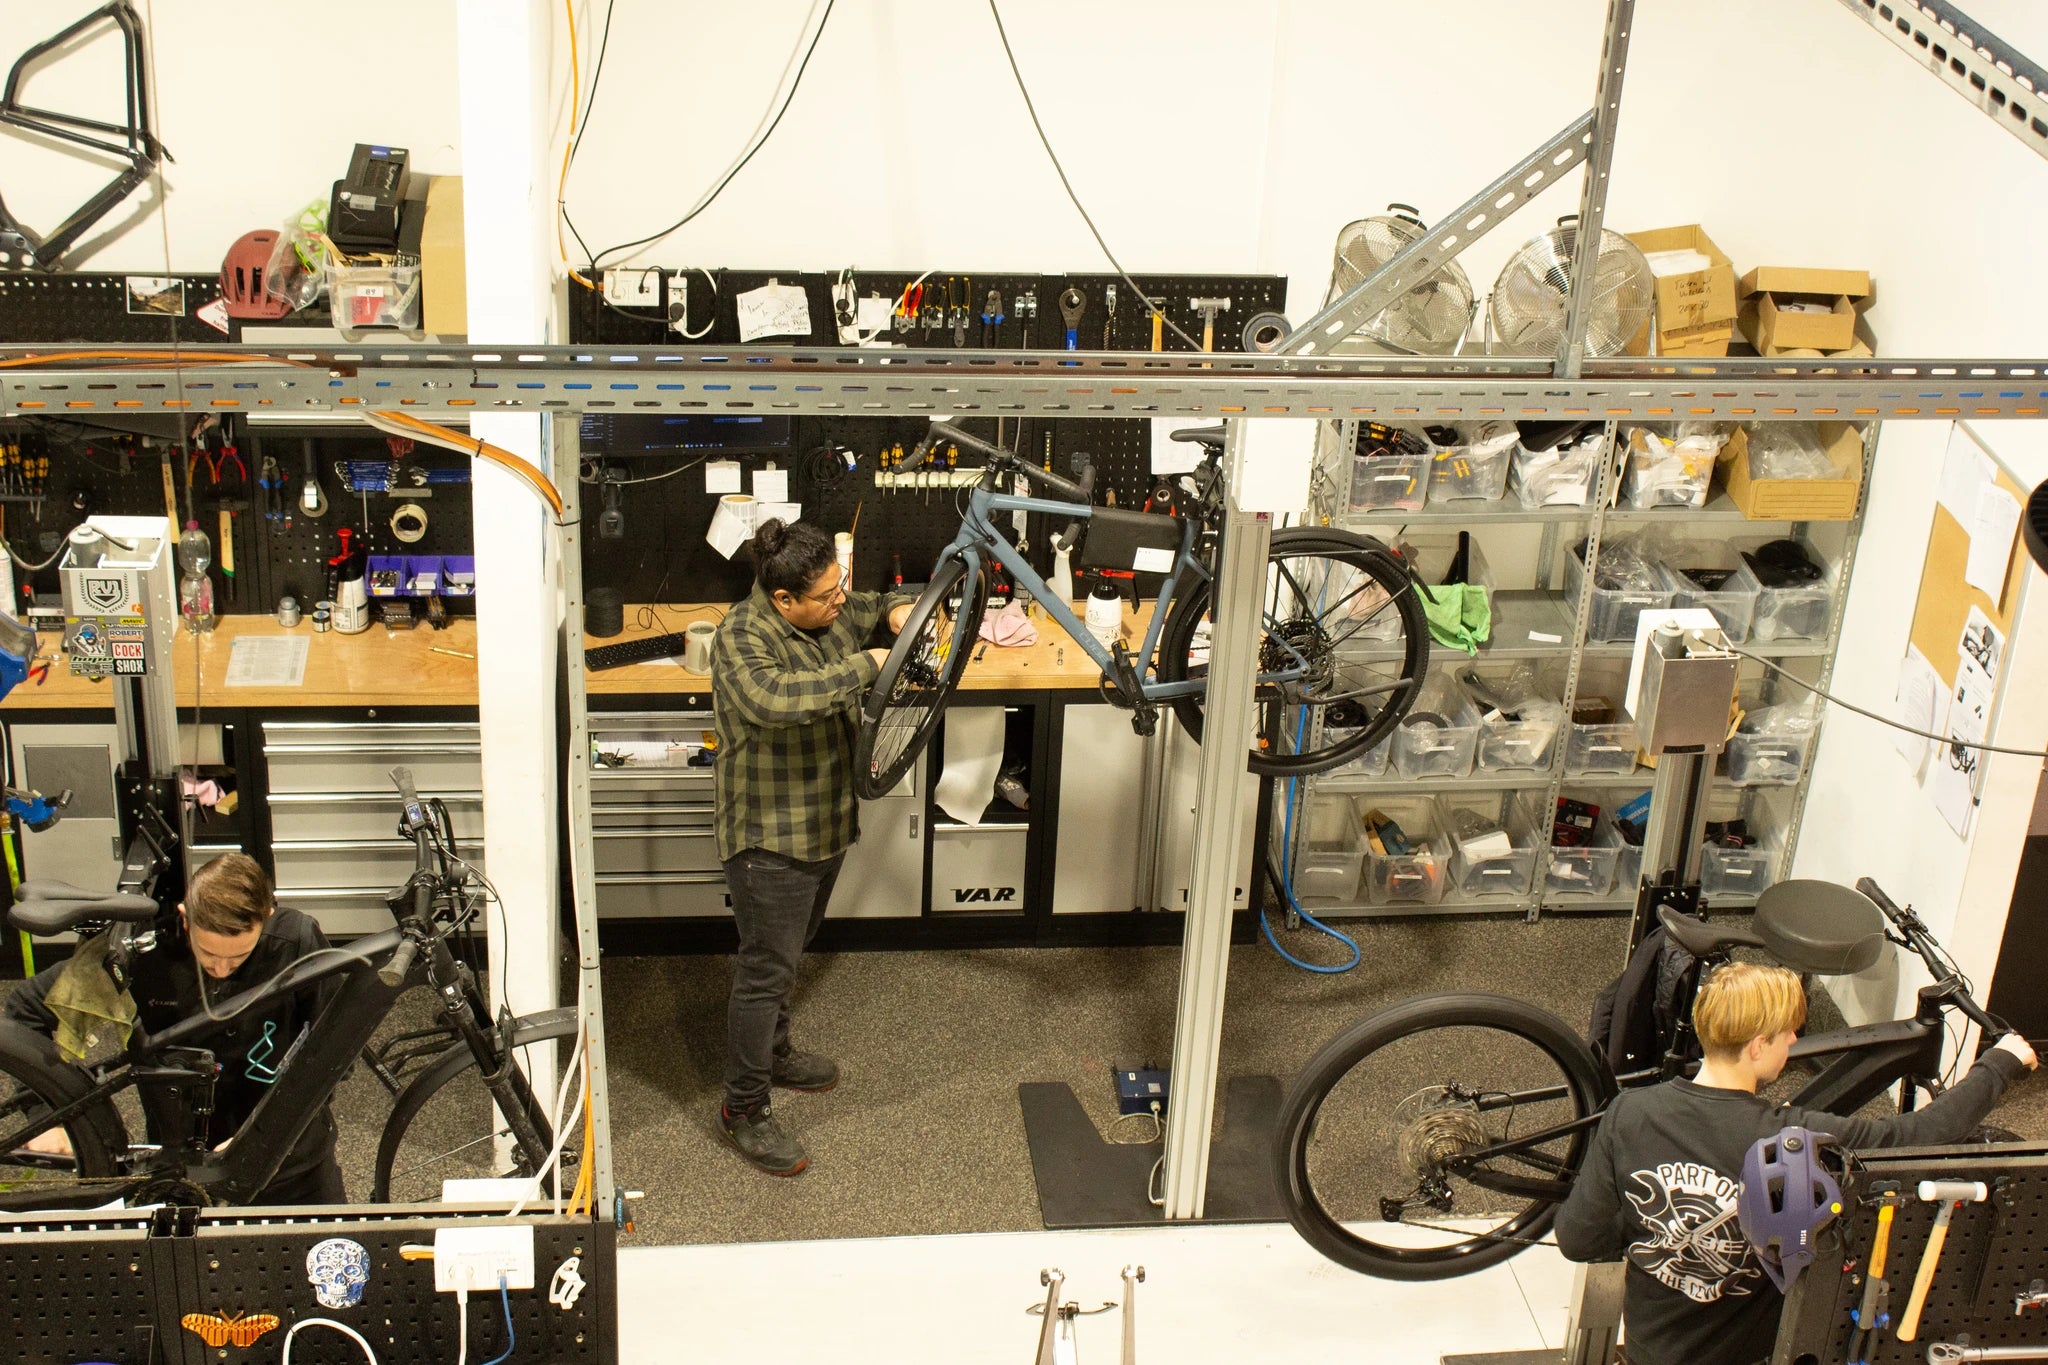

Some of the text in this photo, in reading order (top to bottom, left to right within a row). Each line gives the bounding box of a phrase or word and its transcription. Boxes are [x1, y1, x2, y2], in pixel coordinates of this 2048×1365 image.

[114, 643, 142, 657] COCK
[116, 660, 144, 673] SHOX
[950, 886, 1017, 903] VAR
[1660, 1165, 1713, 1188] PART
[1658, 1270, 1686, 1290] THE
